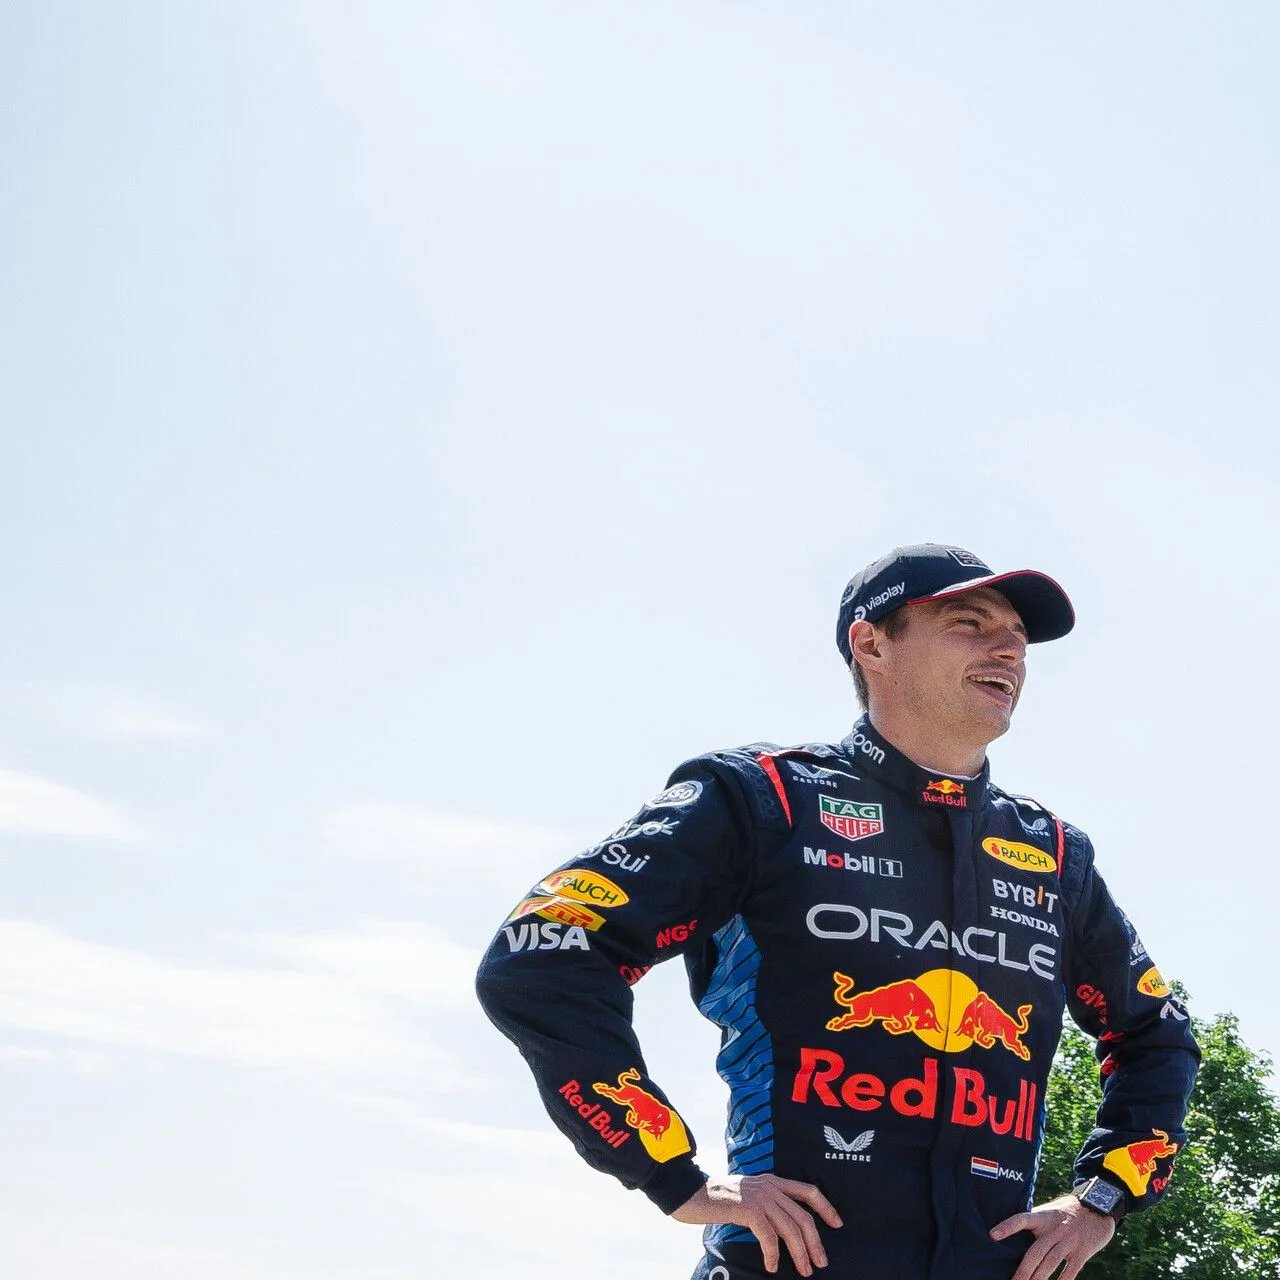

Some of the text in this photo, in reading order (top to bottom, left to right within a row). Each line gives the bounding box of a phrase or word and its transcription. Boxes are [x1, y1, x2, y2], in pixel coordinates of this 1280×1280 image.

[865, 581, 906, 612] viaplay
[793, 775, 838, 789] CASTORE
[823, 798, 877, 819] TAG
[922, 791, 967, 808] Red Bull
[823, 814, 881, 840] HEUER
[602, 843, 651, 873] Sui
[803, 846, 876, 875] Mobil
[1000, 845, 1049, 869] RAUCH
[561, 876, 620, 905] RAUCH
[992, 878, 1059, 914] BYBIT
[989, 905, 1060, 937] HONDA
[500, 921, 591, 953] VISA
[806, 903, 1057, 981] ORACLE
[791, 1047, 1037, 1142] Red Bull
[558, 1079, 631, 1149] Red Bull
[824, 1151, 872, 1163] CASTORE
[997, 1166, 1025, 1183] MAX
